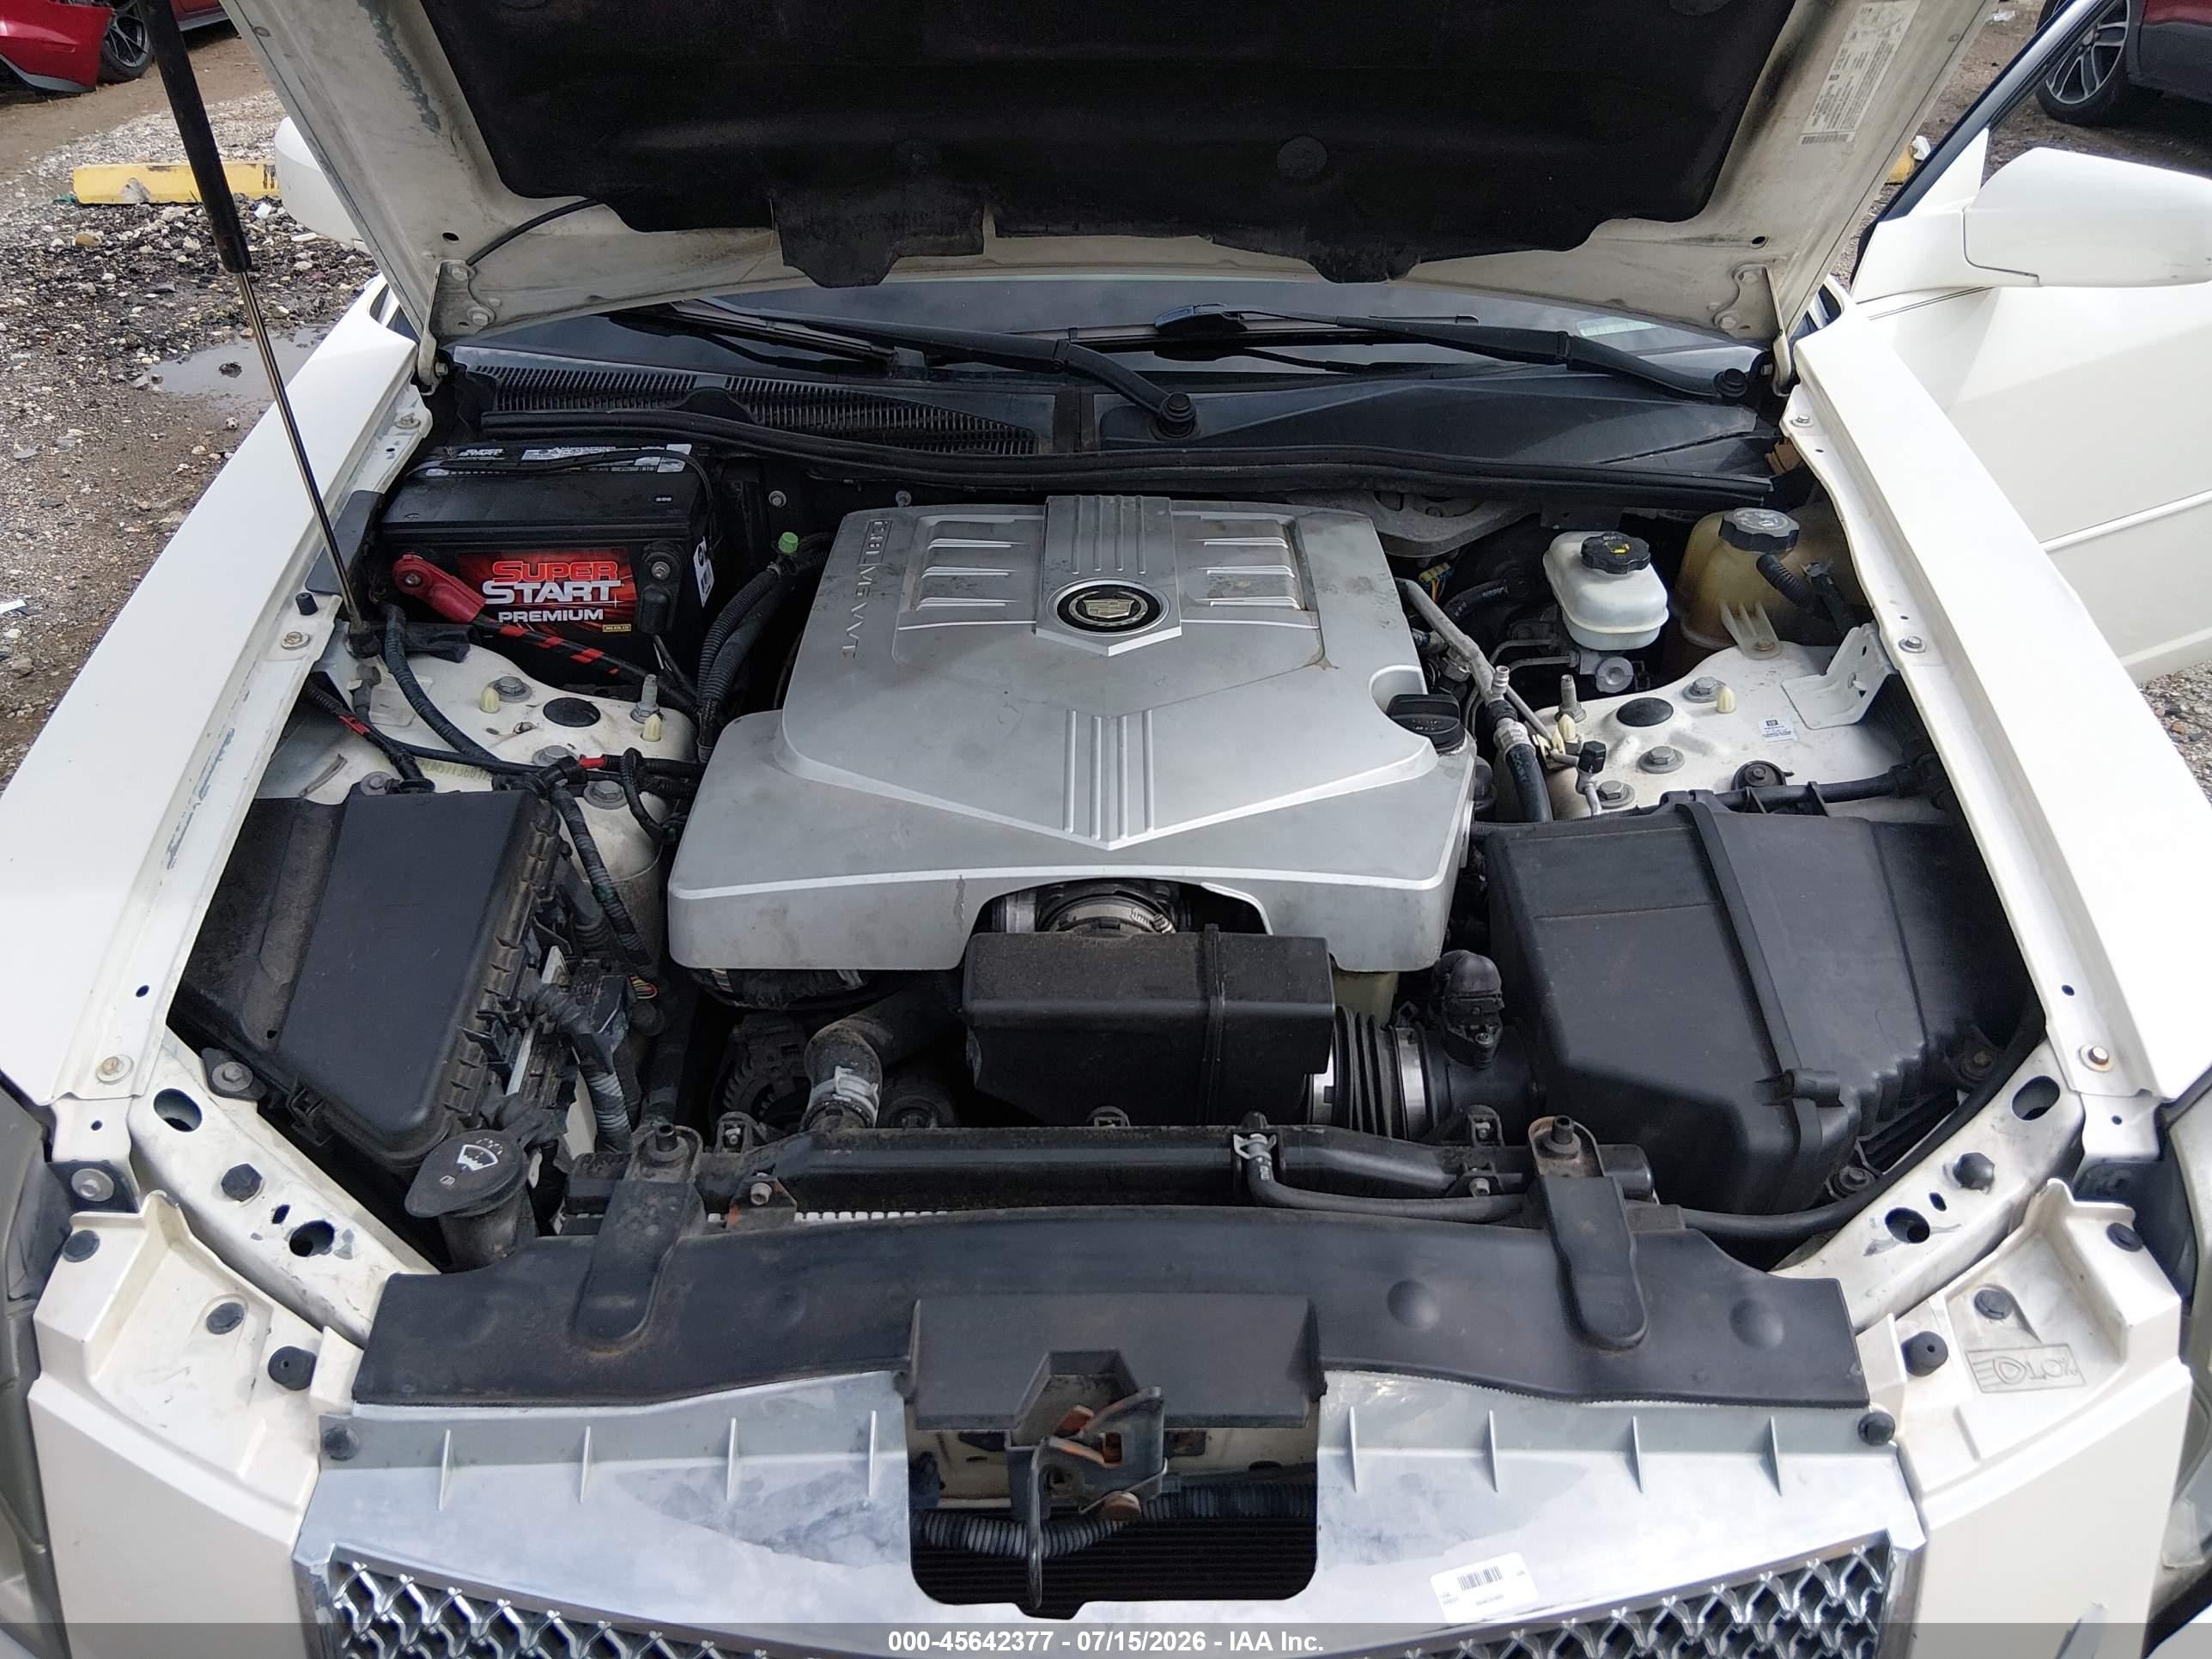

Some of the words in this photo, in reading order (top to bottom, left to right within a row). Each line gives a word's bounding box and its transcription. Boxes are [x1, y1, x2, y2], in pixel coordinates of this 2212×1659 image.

[492, 561, 618, 583] SUPER
[483, 580, 622, 605] START
[498, 609, 604, 623] PREMIUM
[842, 602, 867, 659] VVT
